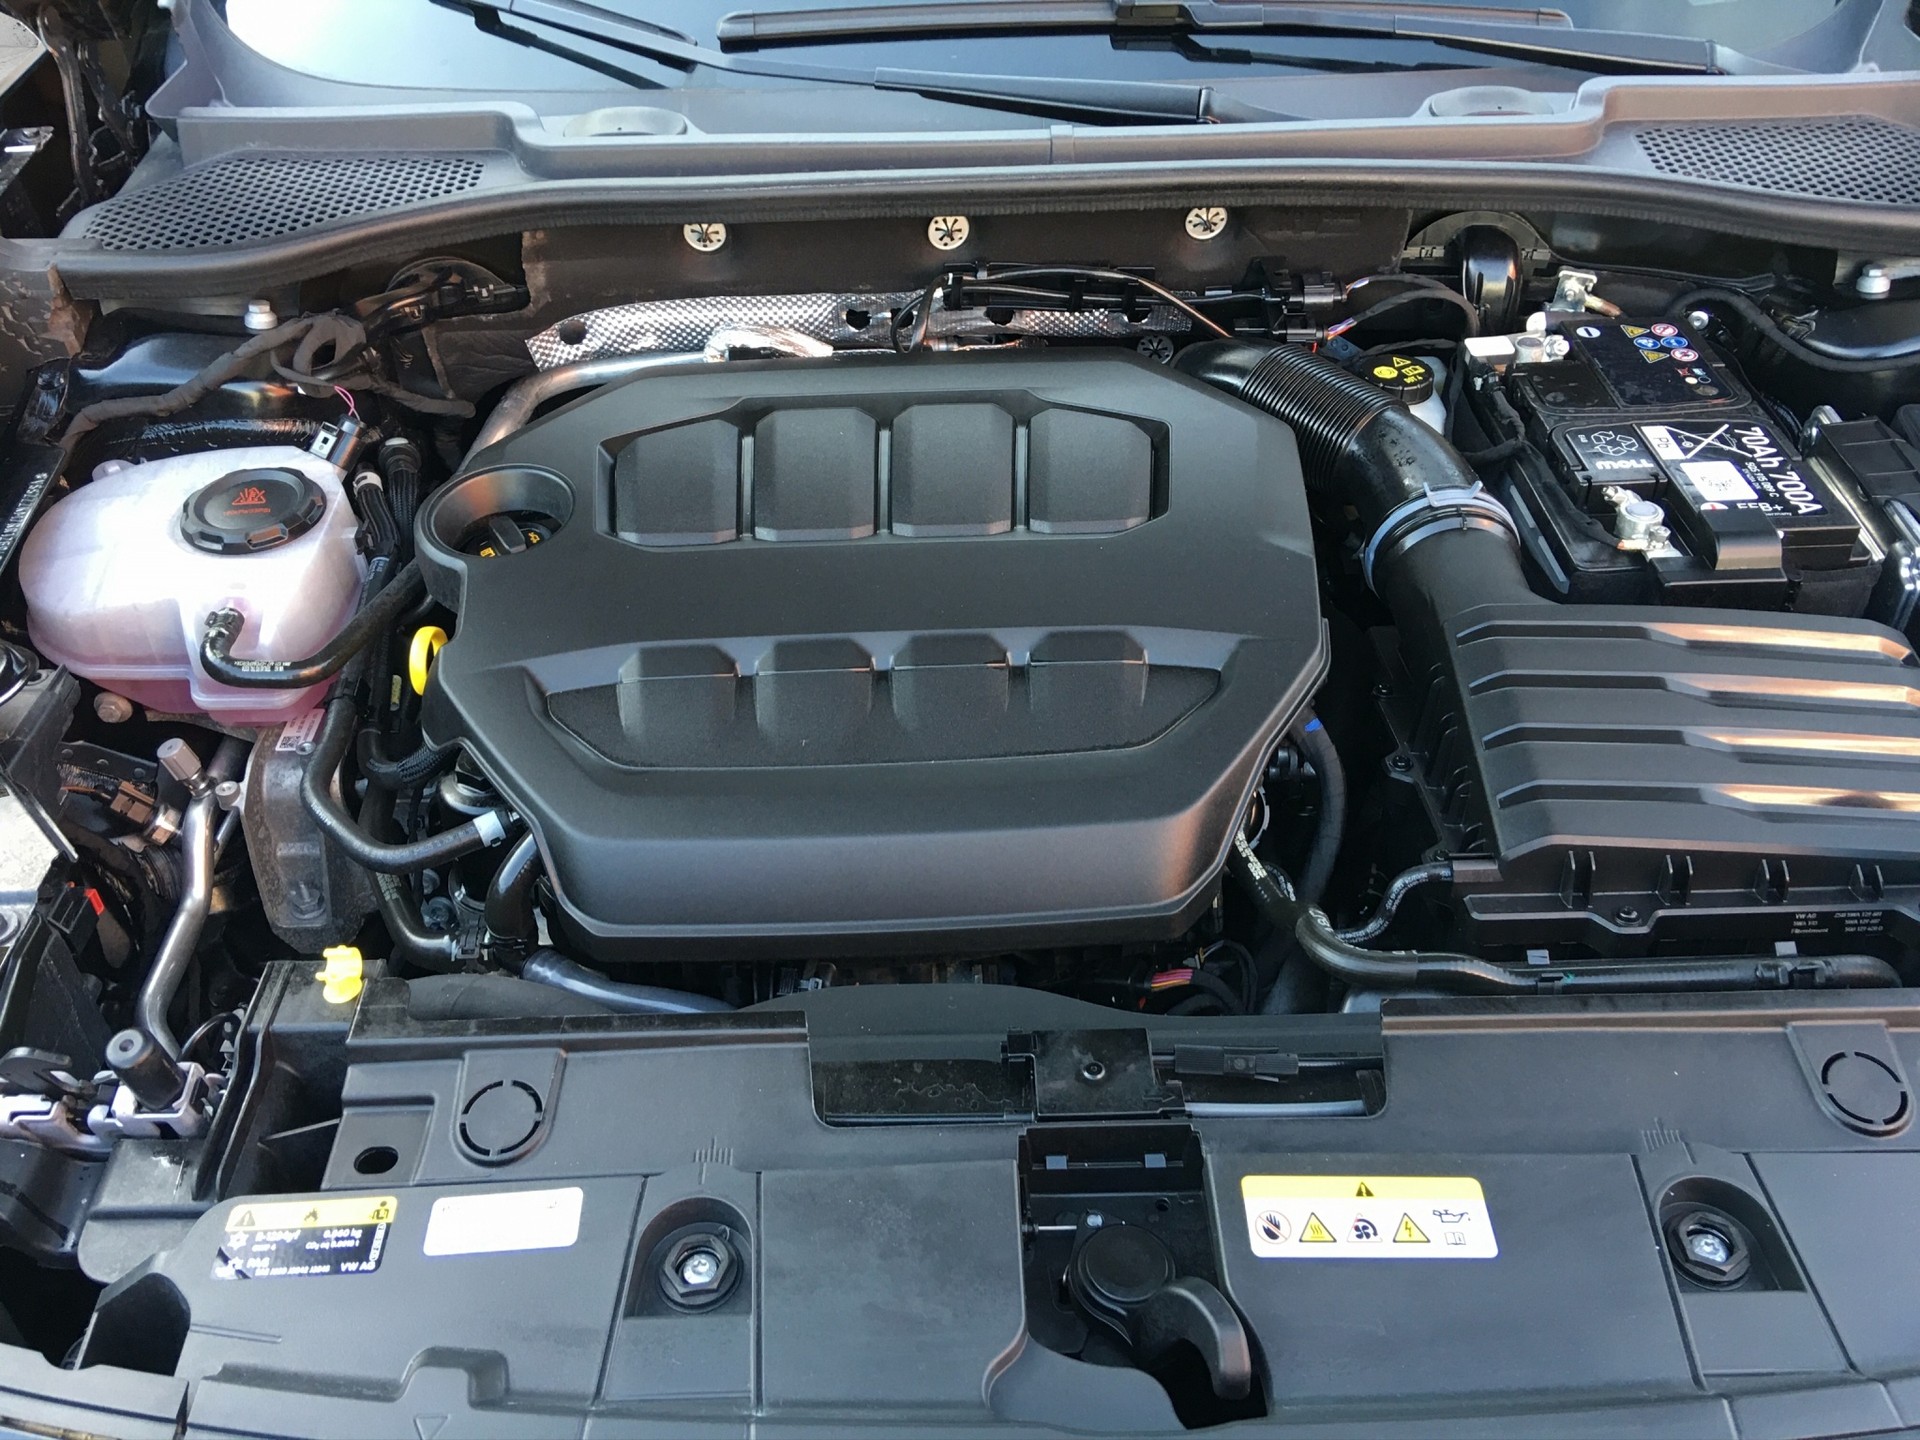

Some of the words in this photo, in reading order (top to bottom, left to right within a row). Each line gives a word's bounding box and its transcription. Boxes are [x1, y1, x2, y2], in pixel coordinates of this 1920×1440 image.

[1653, 437, 1670, 448] Pb
[1734, 426, 1784, 467] 70Ah
[1768, 471, 1823, 514] 700A
[341, 1262, 359, 1271] VW
[359, 1261, 376, 1270] AG
